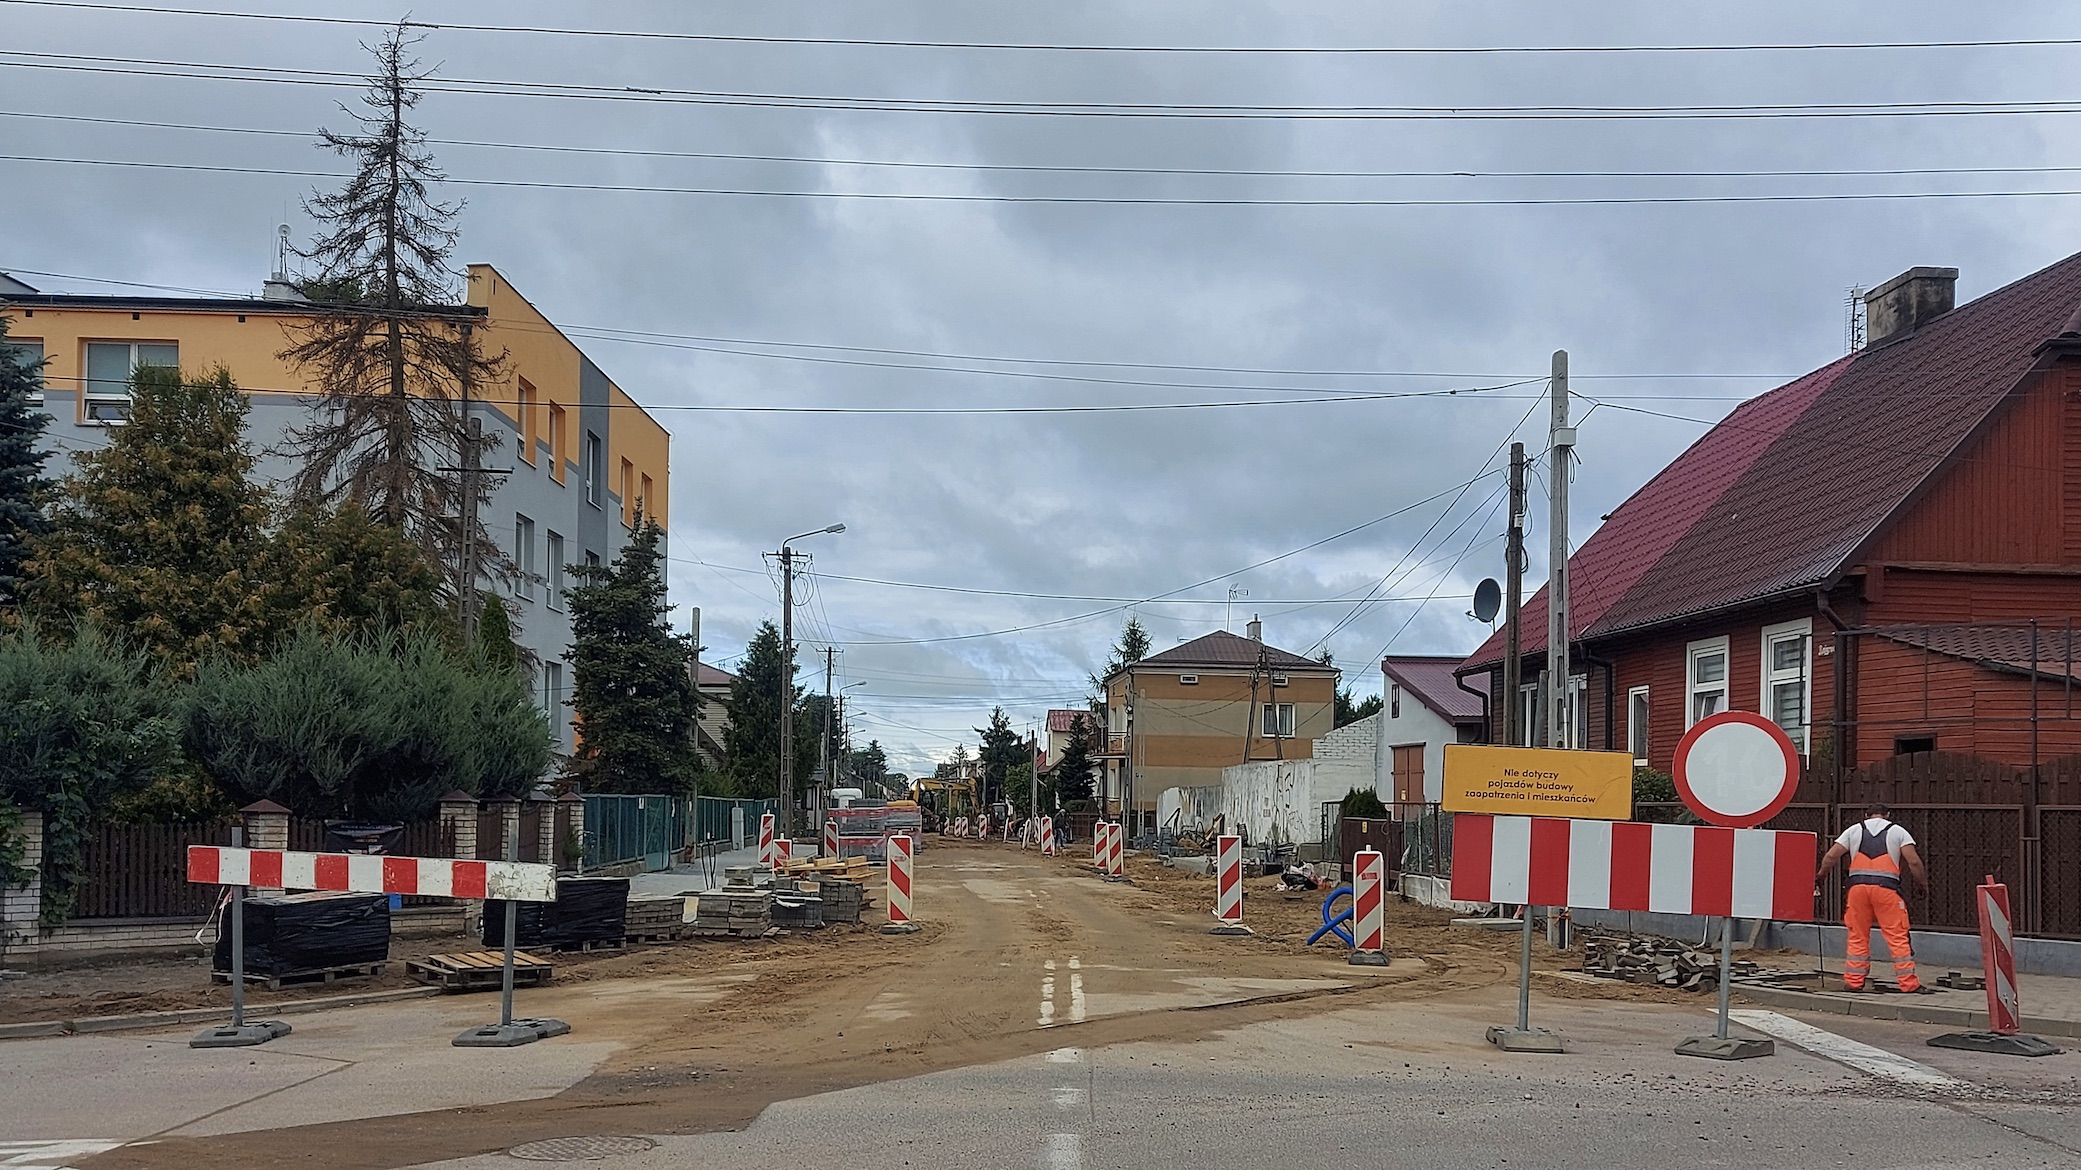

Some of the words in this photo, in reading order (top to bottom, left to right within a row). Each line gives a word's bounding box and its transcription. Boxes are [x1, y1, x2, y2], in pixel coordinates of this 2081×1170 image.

[1504, 768, 1520, 777] Nie
[1522, 769, 1559, 780] dotyczy
[1488, 779, 1534, 789] pojazdów
[1536, 781, 1574, 792] budowy
[1465, 790, 1525, 800] zaopatrzenia
[1532, 792, 1596, 803] mieszkańców
